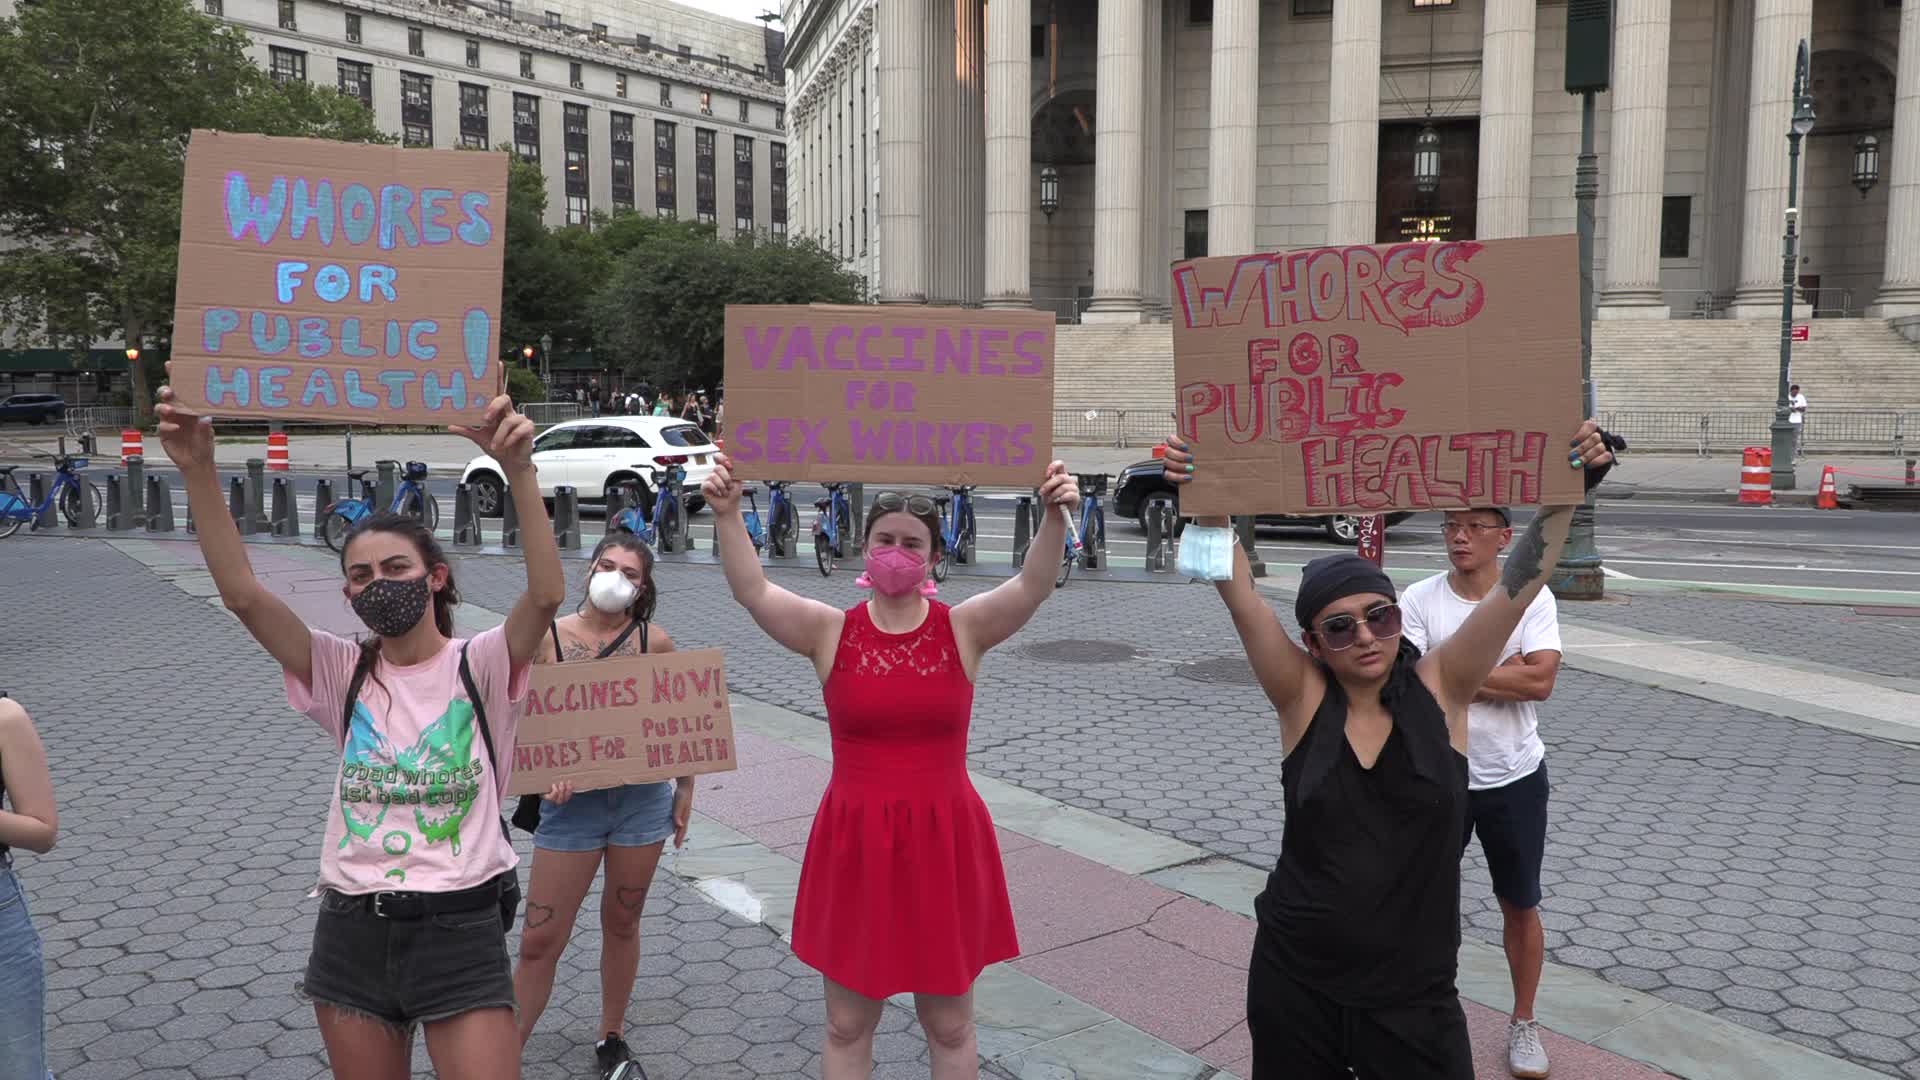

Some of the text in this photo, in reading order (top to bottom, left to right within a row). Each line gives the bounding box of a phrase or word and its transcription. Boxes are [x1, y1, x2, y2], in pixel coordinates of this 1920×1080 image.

[224, 171, 493, 249] WHORES
[275, 260, 398, 304] FOR
[1173, 242, 1484, 336] WHORES
[203, 307, 439, 360] PUBLIC
[742, 325, 1046, 376] VACCINES
[1247, 332, 1364, 385] FOR
[845, 380, 917, 412] FOR
[1180, 373, 1407, 444] PUBLIC
[733, 417, 1036, 467] SEX WORKERS
[1301, 429, 1548, 510] HEALTH
[525, 666, 722, 716] ACCINES NOW!
[589, 735, 626, 761] FOR
[642, 714, 714, 738] PUBLIC
[402, 758, 483, 786] whores
[646, 738, 729, 768] HEALTH
[376, 786, 420, 805] bad
